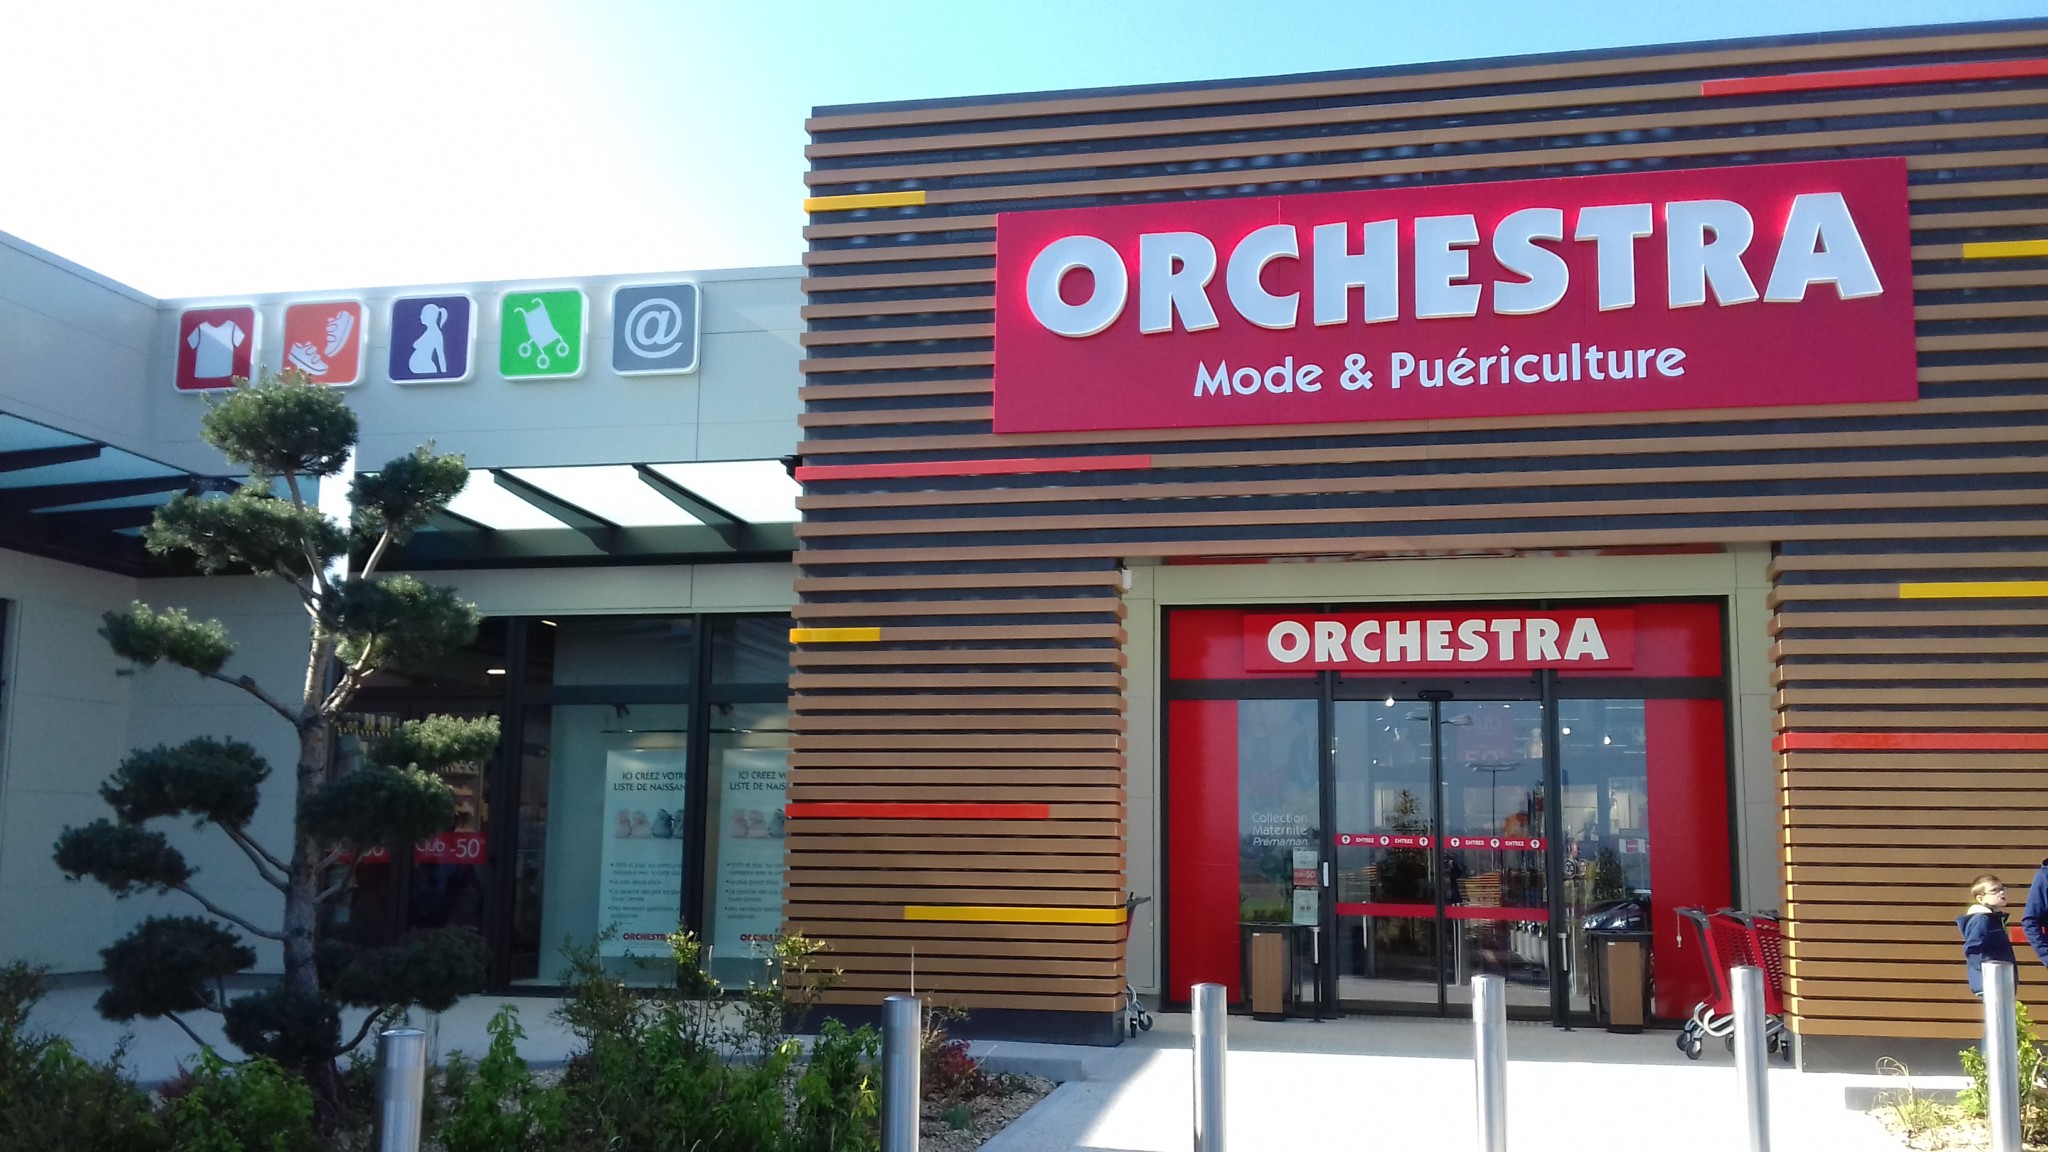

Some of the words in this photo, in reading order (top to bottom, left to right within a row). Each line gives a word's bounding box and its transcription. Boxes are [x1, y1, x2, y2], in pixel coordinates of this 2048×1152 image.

[1026, 191, 1884, 338] ORCHESTRA
[1194, 356, 1324, 397] Mode
[1340, 352, 1373, 391] &
[1391, 342, 1687, 390] Puériculture
[1267, 617, 1609, 664] ORCHESTRA
[622, 771, 633, 780] ICI
[635, 771, 660, 780] CREEZ
[662, 771, 686, 780] VOTR
[738, 771, 749, 780] ICI
[751, 771, 777, 780] CREEZ
[614, 782, 634, 791] LISTE
[636, 782, 648, 791] DE
[650, 782, 686, 791] NAISSAN
[729, 782, 750, 790] LISTE
[752, 782, 764, 790] DE
[1252, 812, 1308, 823] Collection
